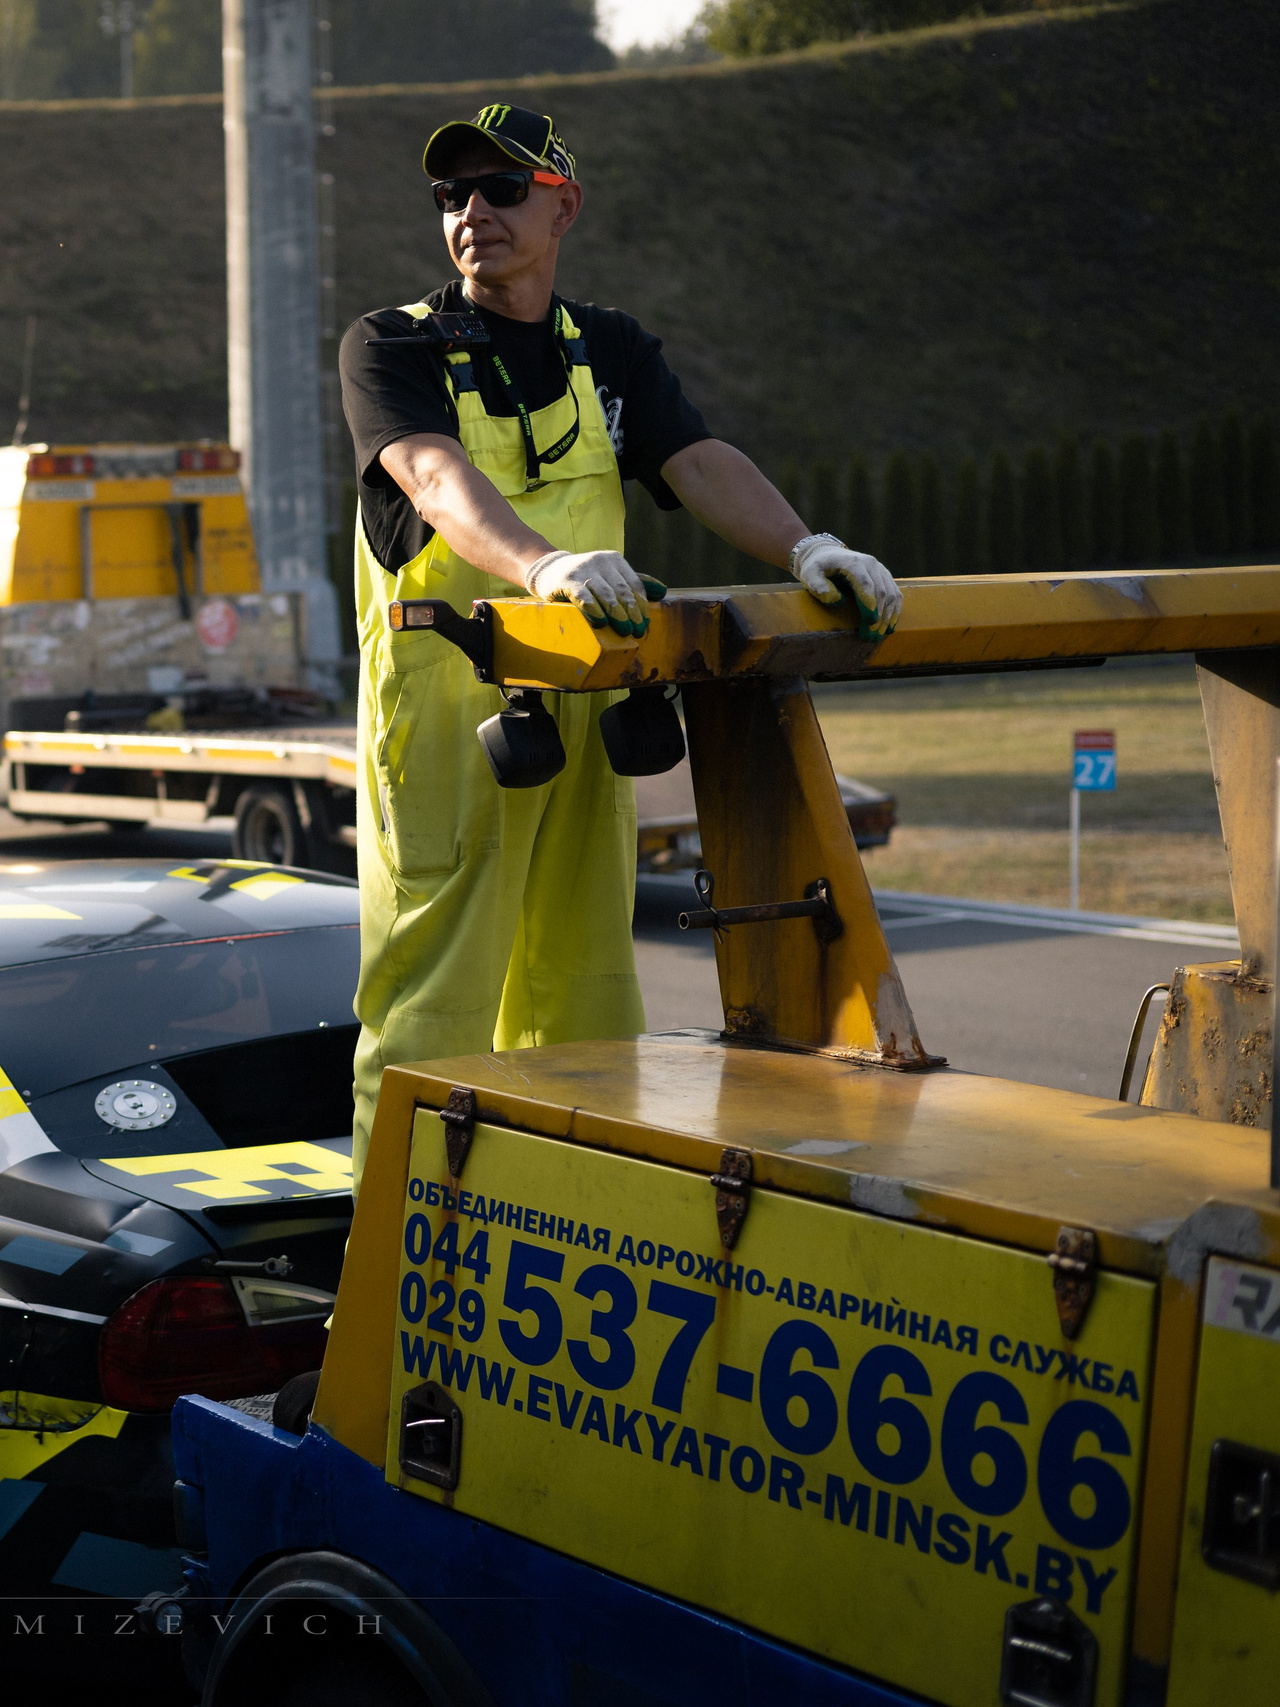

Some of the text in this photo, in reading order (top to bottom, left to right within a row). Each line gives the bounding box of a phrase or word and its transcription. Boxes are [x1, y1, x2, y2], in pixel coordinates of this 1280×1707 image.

[1075, 755, 1116, 786] 27
[400, 1271, 486, 1343] 029
[404, 1212, 491, 1284] 044
[408, 1177, 1140, 1402] ОБЪЕДИНЕННАЯ ДОРОЖНО-АВАРИЙНАЯ СЛУЖБА
[498, 1239, 1132, 1551] 537-6666
[400, 1329, 1118, 1615] WWW.EVAKYATOR-MINSK.BY
